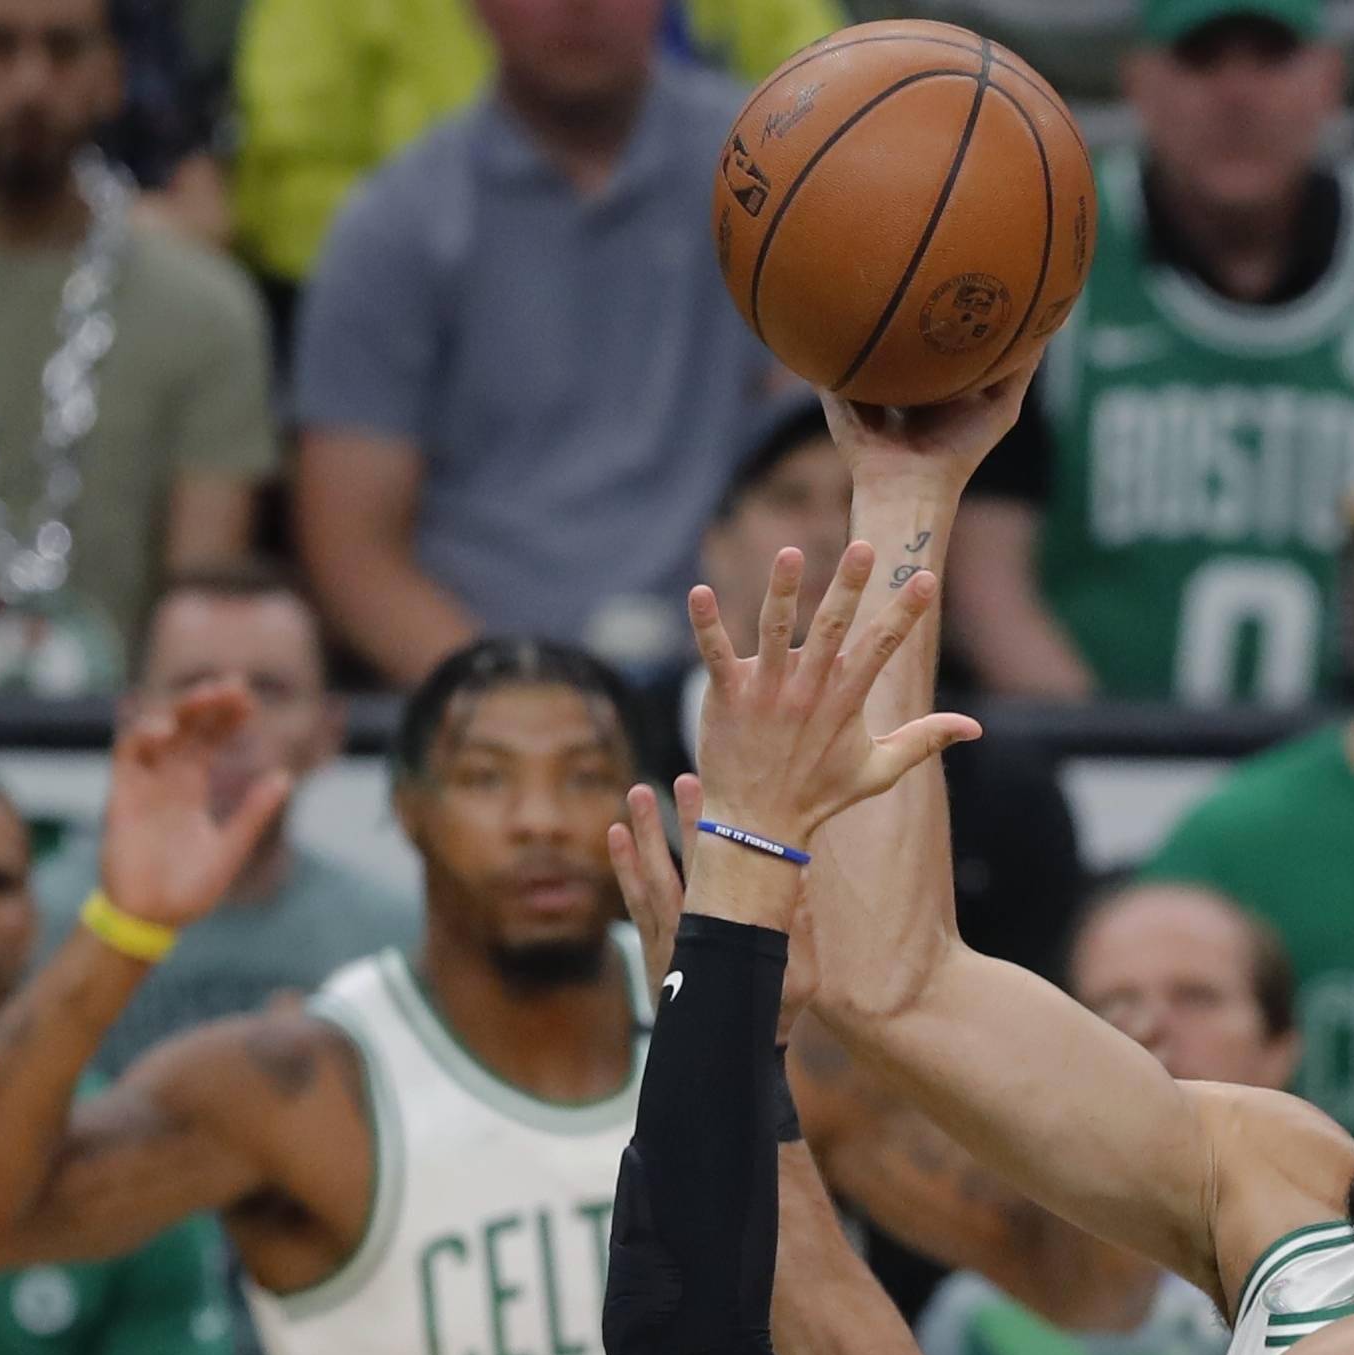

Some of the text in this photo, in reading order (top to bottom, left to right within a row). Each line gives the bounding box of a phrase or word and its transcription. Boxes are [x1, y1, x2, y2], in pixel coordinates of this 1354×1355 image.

[715, 825, 785, 855] PAY IT FORWARD
